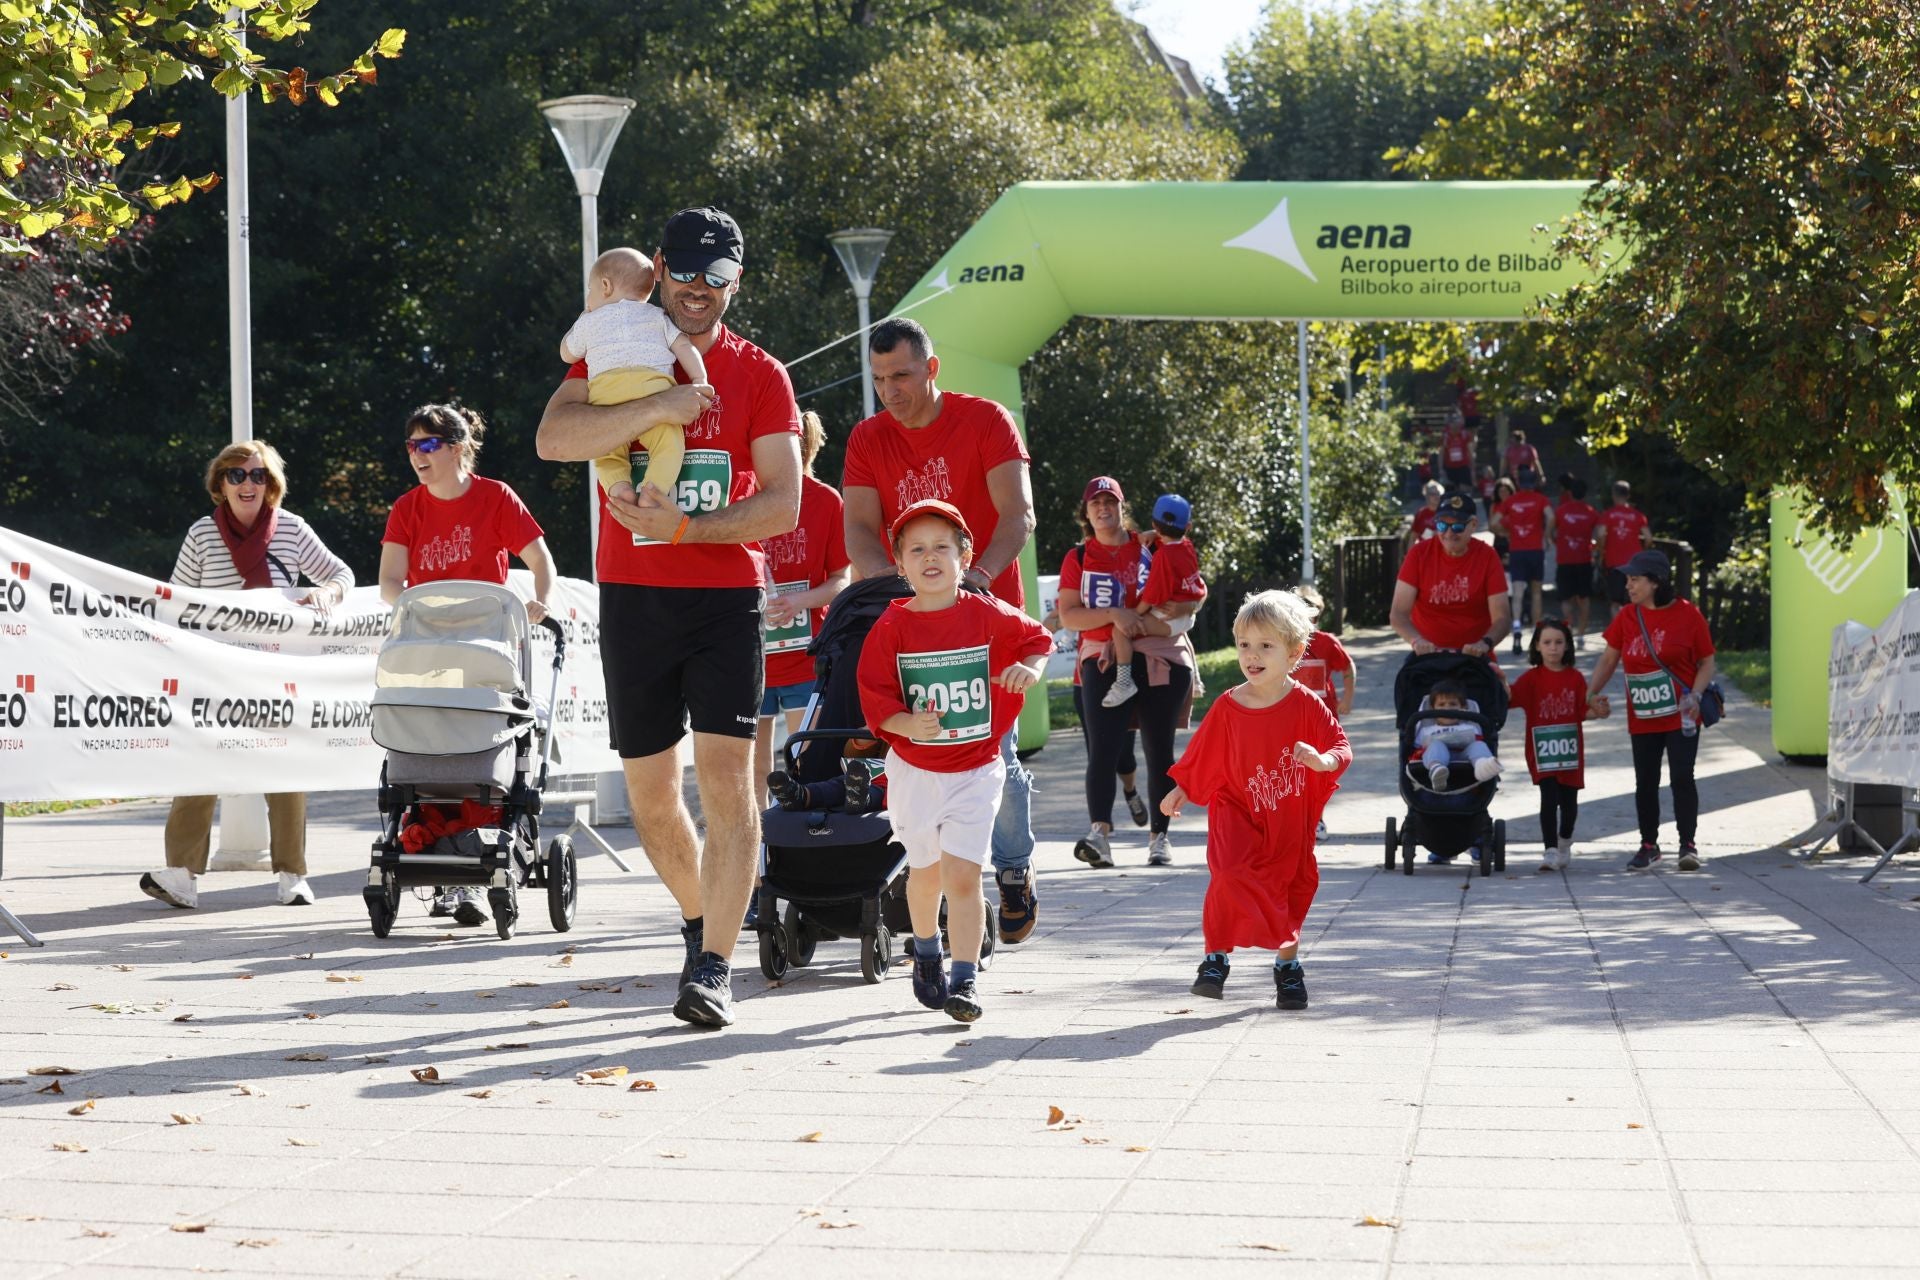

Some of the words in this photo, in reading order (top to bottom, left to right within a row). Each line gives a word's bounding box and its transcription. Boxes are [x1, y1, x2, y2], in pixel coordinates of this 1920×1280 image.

[1316, 224, 1412, 250] aena
[959, 264, 1025, 283] aena
[1340, 256, 1460, 278] Aeropuerto
[1466, 254, 1492, 272] de
[1498, 254, 1563, 272] Bilbao
[1341, 278, 1414, 295] Bilboko
[1419, 278, 1522, 297] aireportua
[50, 583, 77, 615] EL
[178, 602, 206, 630] EL
[206, 605, 294, 635] CORREO
[1, 624, 27, 636] VALOR
[134, 630, 149, 642] CON
[908, 677, 987, 715] 2059
[1630, 684, 1671, 705] 2003
[54, 694, 80, 728] EL
[84, 695, 173, 728] CORREO
[191, 697, 213, 728] EL
[216, 698, 294, 728] CORREO
[311, 700, 329, 728] EL
[82, 739, 129, 750] INFORMAZIO
[130, 738, 169, 749] BALIOTSUA
[216, 738, 255, 750] INFORMAZIO
[1537, 738, 1578, 757] 2003
